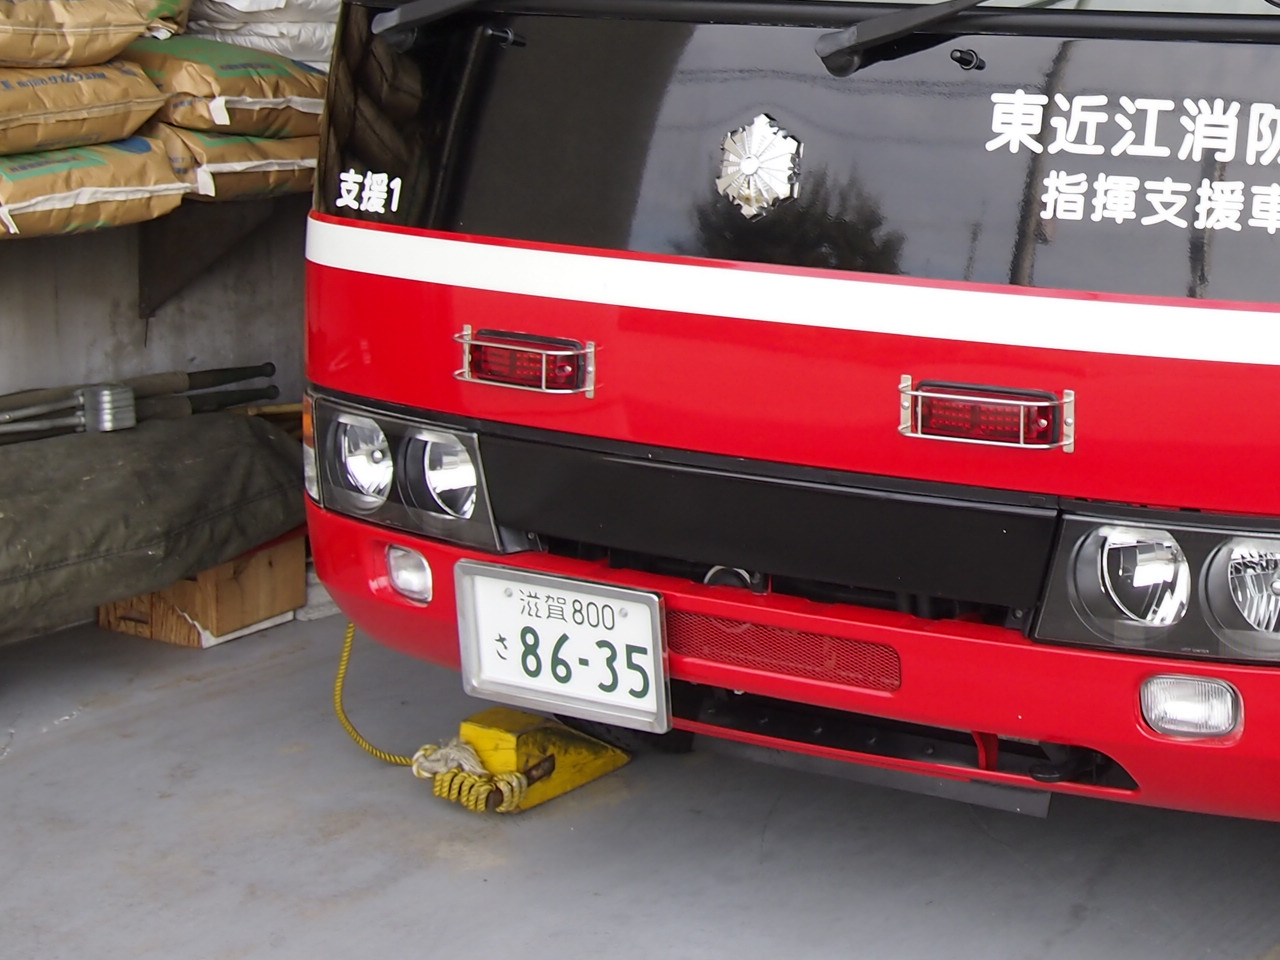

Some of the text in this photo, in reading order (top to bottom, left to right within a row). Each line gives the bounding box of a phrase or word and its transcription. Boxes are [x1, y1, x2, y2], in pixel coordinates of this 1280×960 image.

[336, 169, 402, 214] 支援1
[494, 625, 650, 699] さ 86-35
